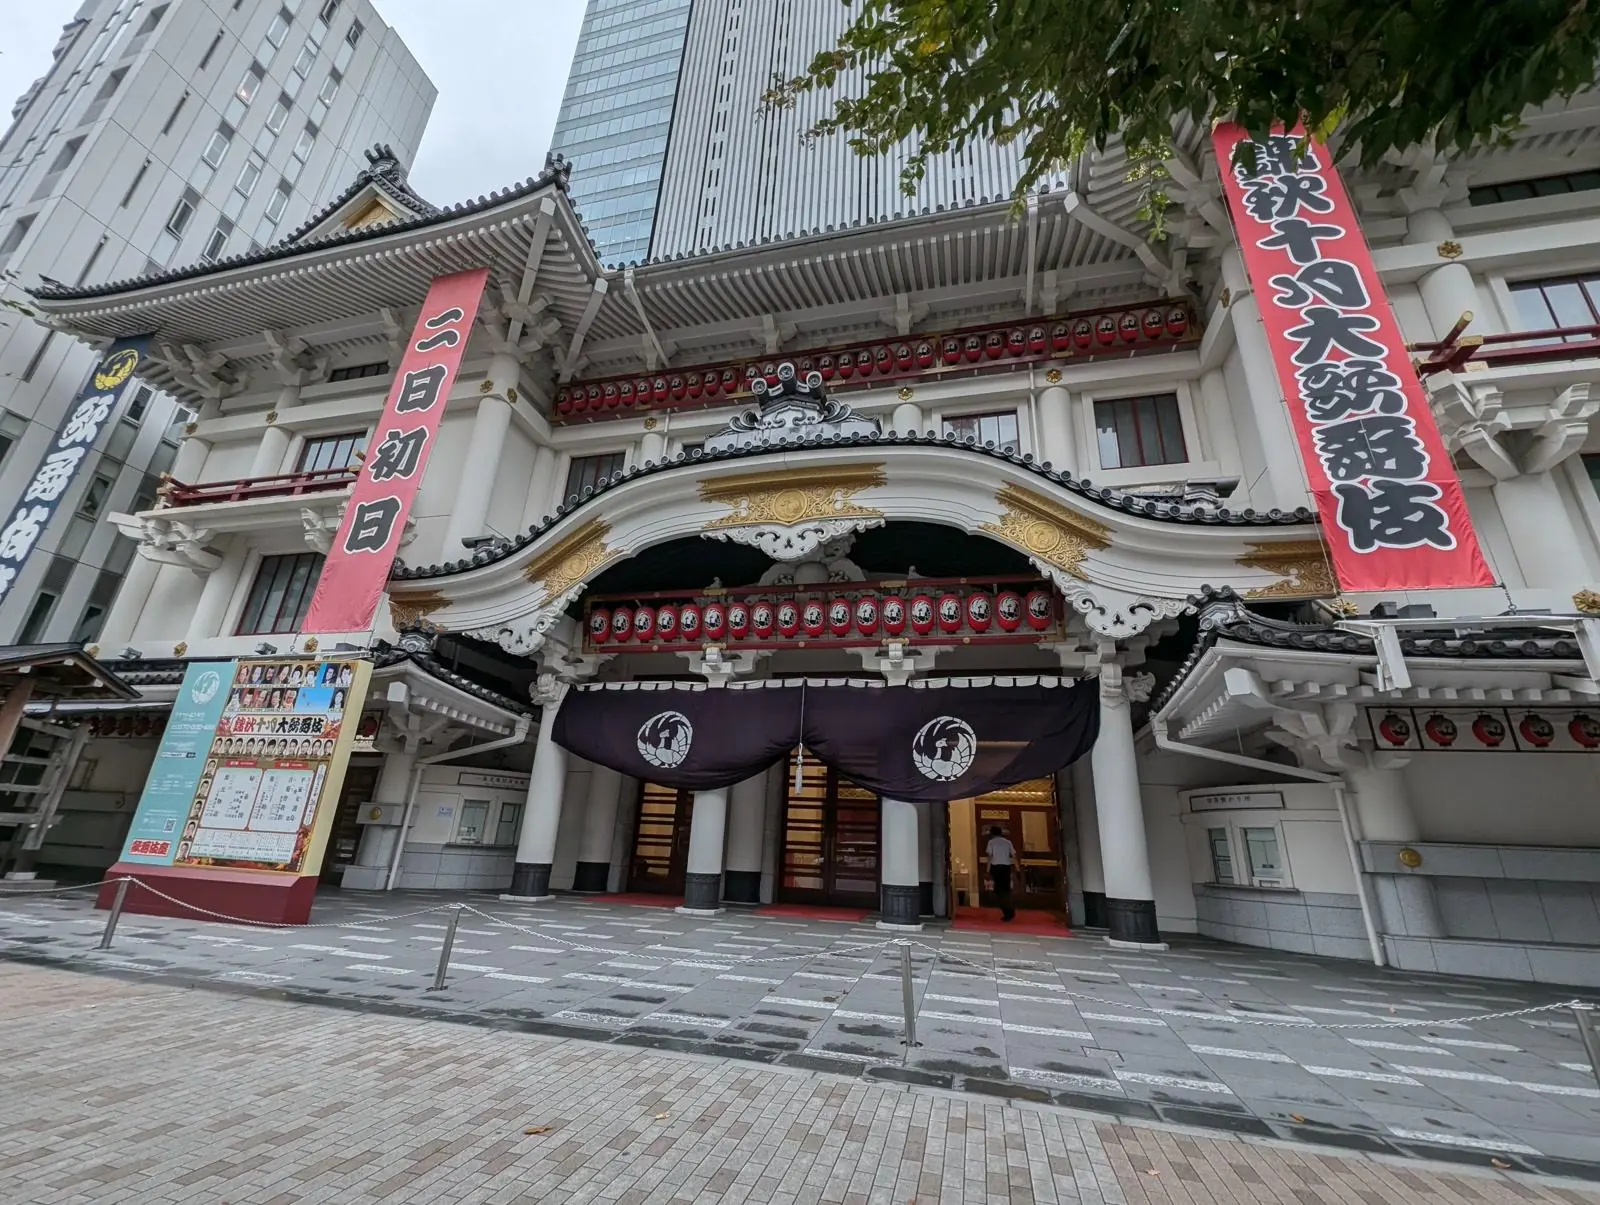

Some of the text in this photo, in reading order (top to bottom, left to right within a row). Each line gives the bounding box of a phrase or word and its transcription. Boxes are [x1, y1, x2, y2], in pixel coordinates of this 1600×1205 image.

[343, 307, 464, 555] 二日初日
[233, 716, 324, 734] 錦秋十月大歌舞伎
[131, 840, 170, 855] 歌舞伎座
